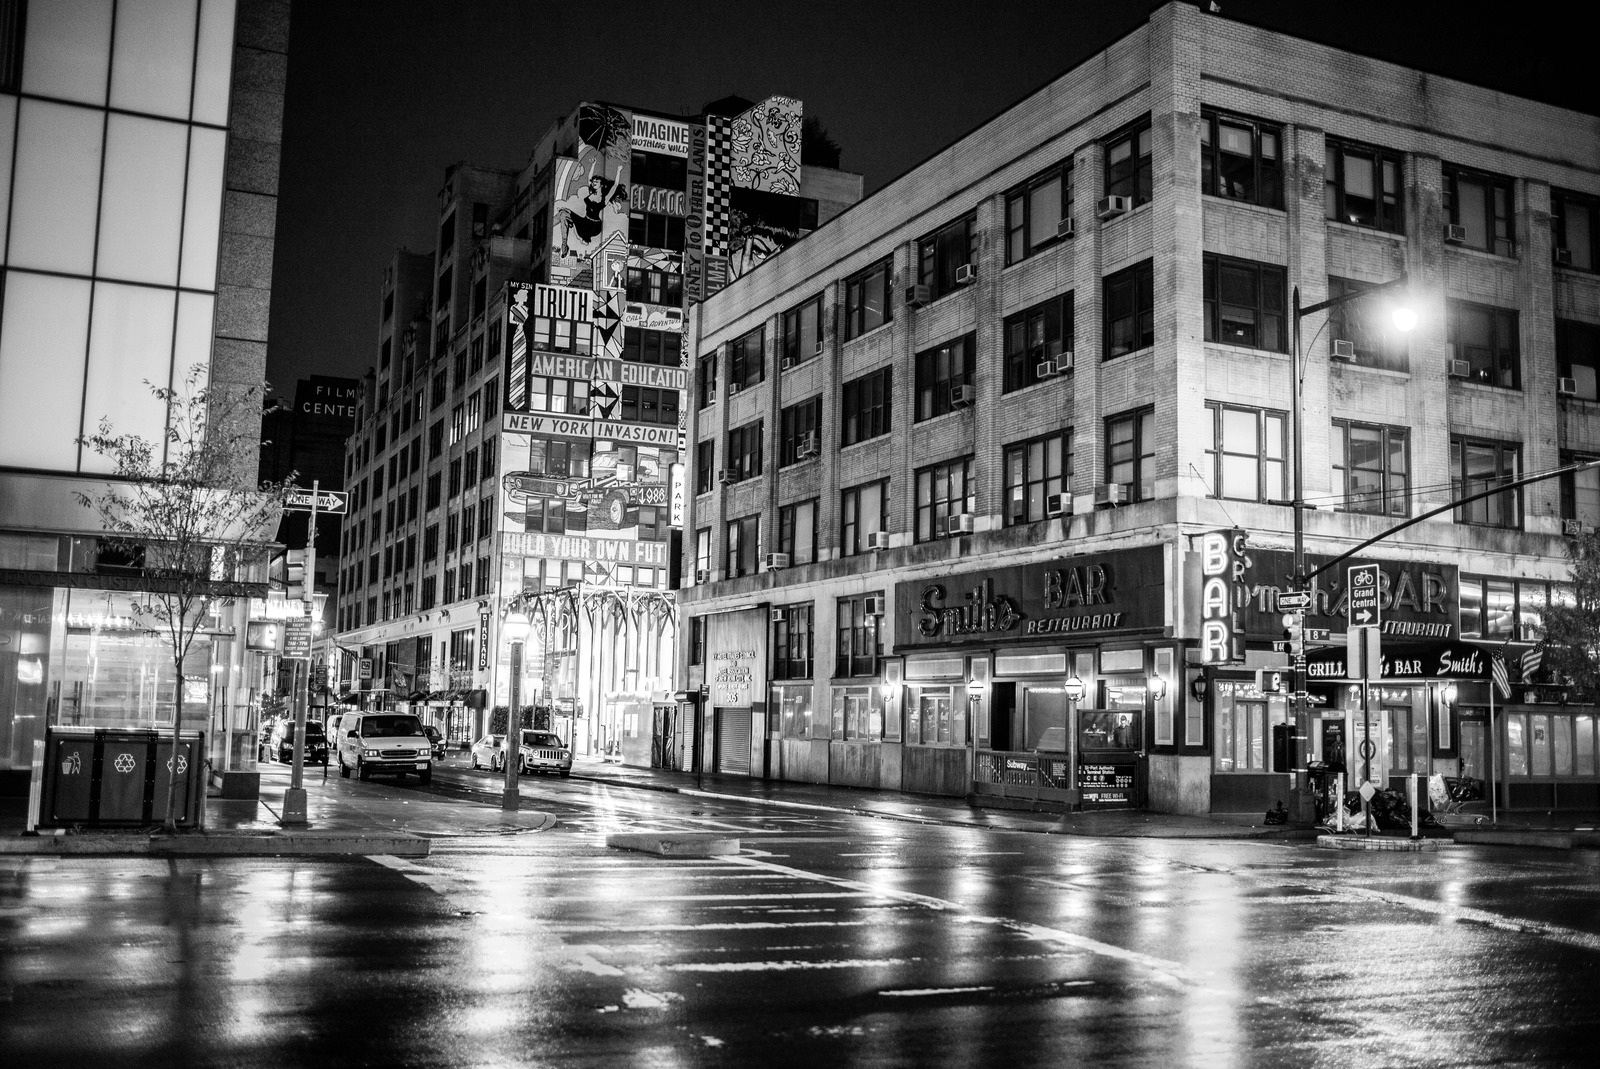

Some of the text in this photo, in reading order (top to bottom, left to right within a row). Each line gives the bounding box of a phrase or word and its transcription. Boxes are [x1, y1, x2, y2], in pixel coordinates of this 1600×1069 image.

[632, 119, 689, 145] IMAGINE
[631, 137, 689, 154] NOTHING WILD
[687, 127, 705, 177] LANDS
[630, 184, 686, 216] EL AMOR
[685, 179, 703, 229] OTHER
[521, 282, 533, 290] SIN
[538, 286, 588, 322] TRUTH
[531, 354, 614, 381] AMERICAN
[316, 386, 355, 399] FILM
[509, 415, 674, 443] NEW YORK INVASION!
[318, 496, 338, 507] WAY
[673, 481, 683, 521] PARK
[503, 532, 546, 556] BUILD
[551, 535, 591, 559] YOUR
[596, 539, 630, 562] OWN
[1044, 565, 1107, 610] BAR
[1203, 533, 1228, 663] BAR
[1233, 535, 1246, 660] GRILL
[1354, 588, 1374, 598] Grand
[1377, 570, 1448, 614] BAR
[1280, 597, 1292, 605] ONE
[1351, 598, 1377, 608] Central
[1027, 611, 1121, 634] RESTAURANT
[1312, 630, 1319, 640] 8
[1380, 619, 1453, 638] STAURANT
[480, 612, 489, 667] BIRDLAND
[1308, 663, 1346, 677] GRILL
[1394, 660, 1423, 675] BAR
[1437, 651, 1484, 676] Smith's
[1006, 759, 1028, 771] Subway
